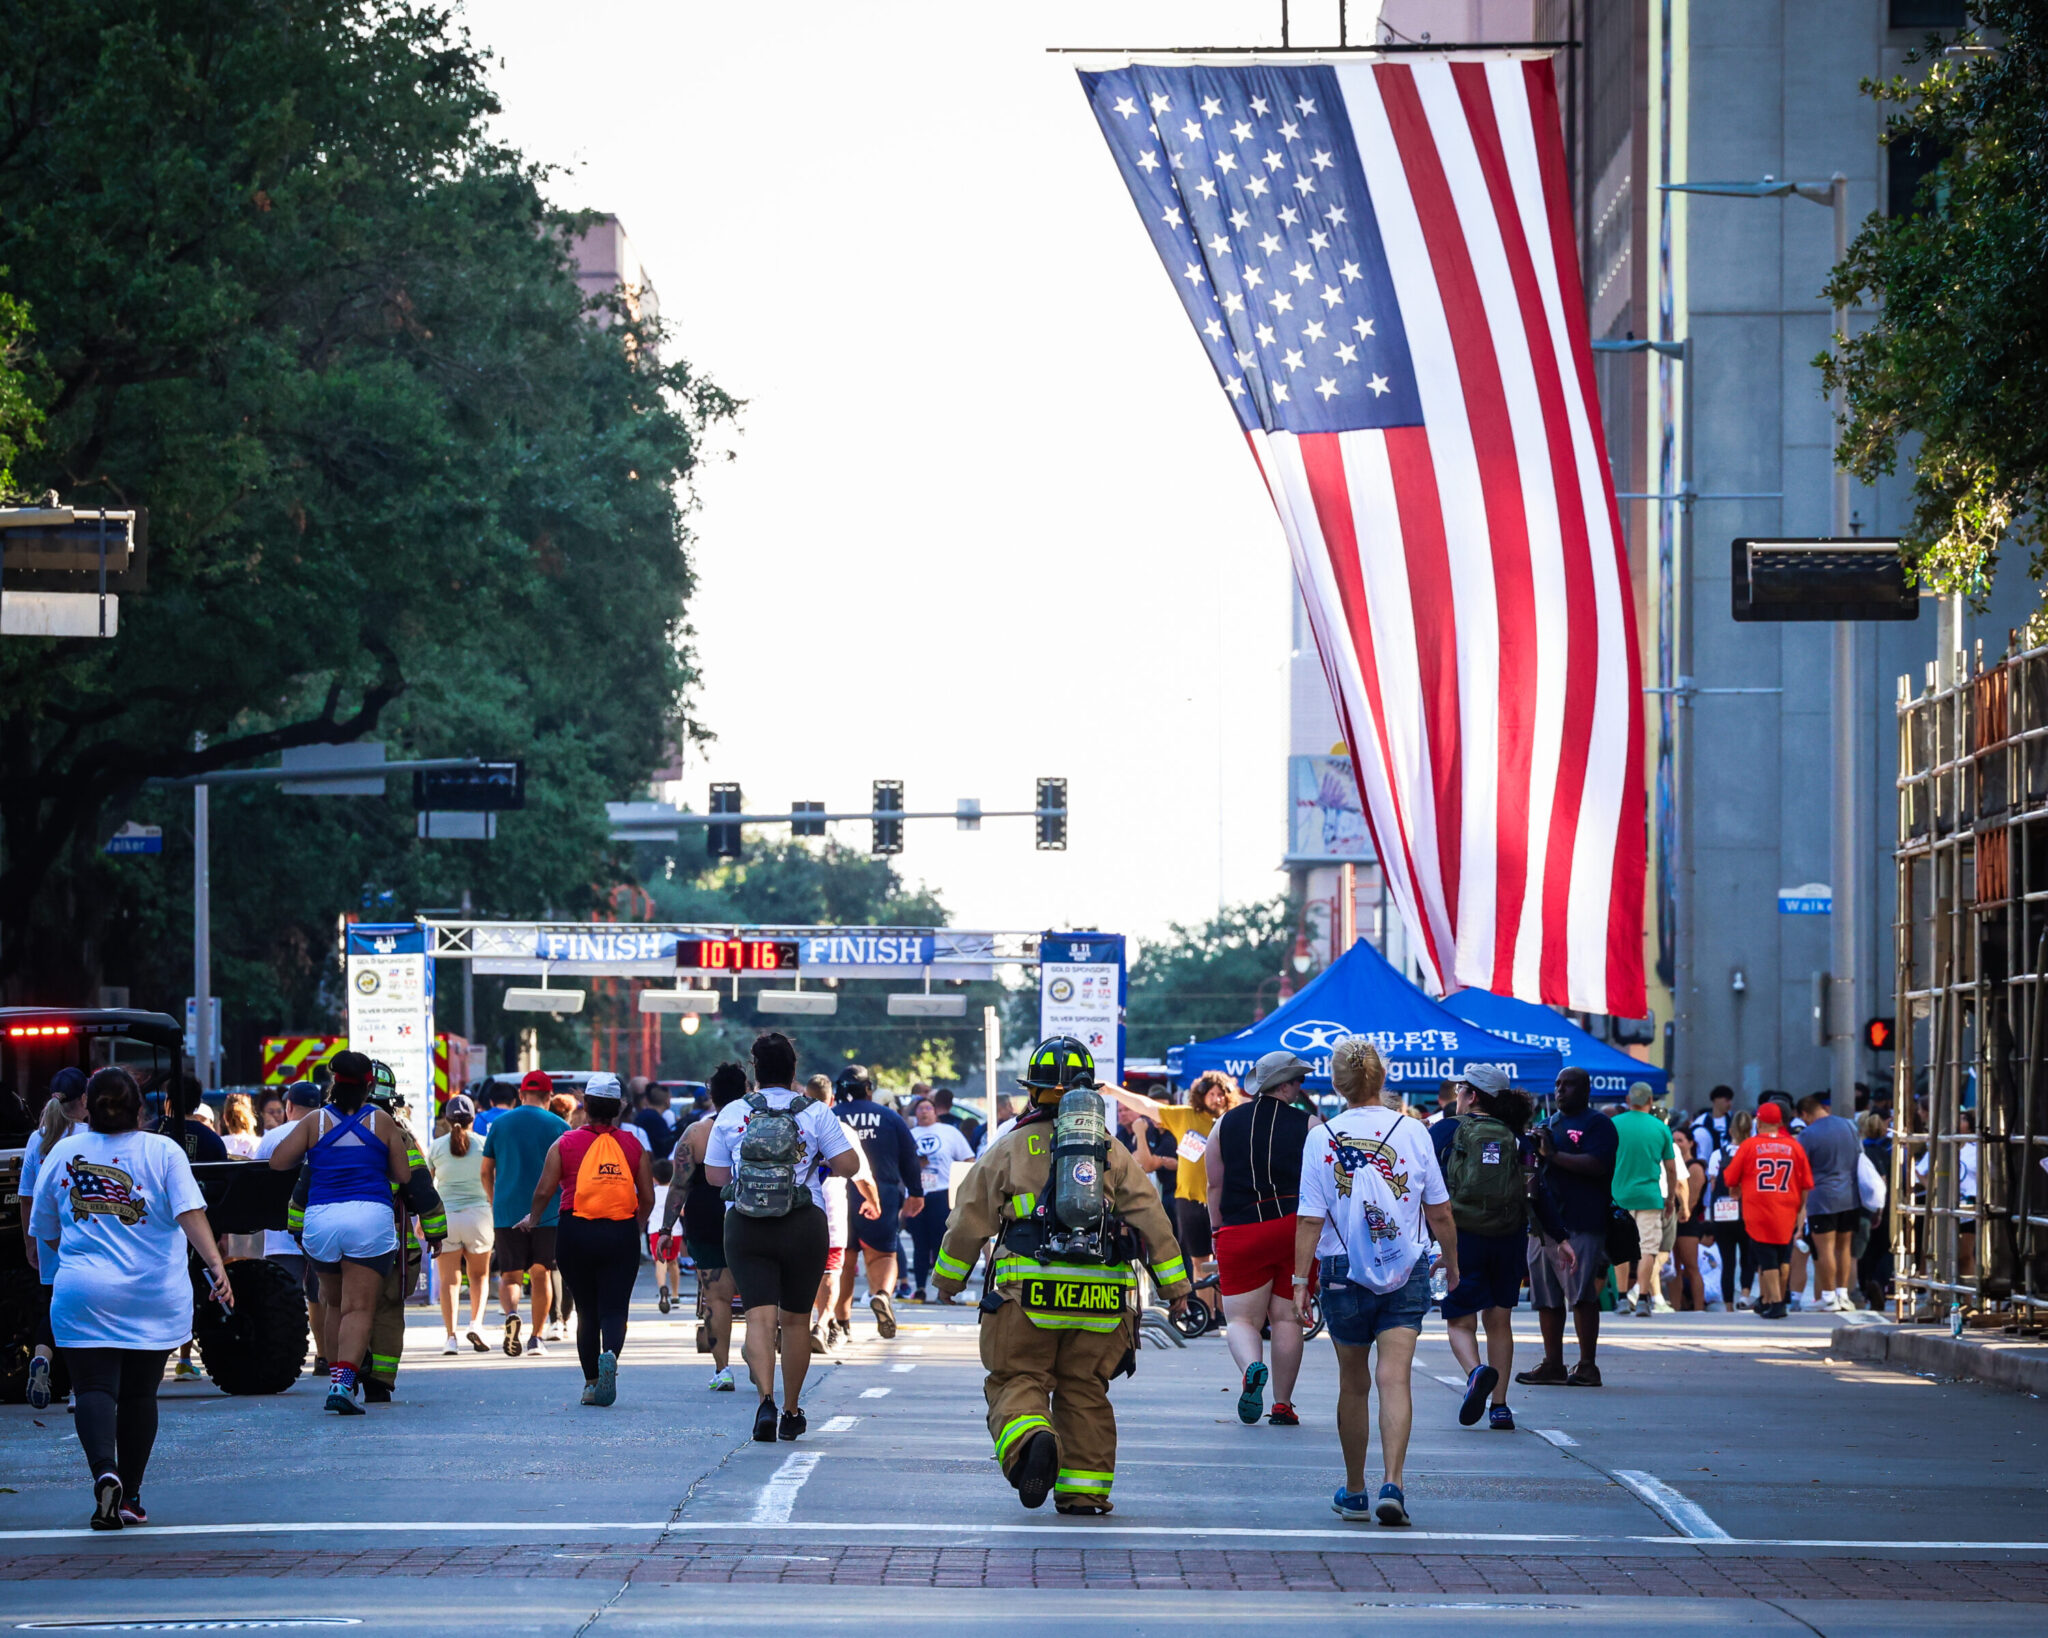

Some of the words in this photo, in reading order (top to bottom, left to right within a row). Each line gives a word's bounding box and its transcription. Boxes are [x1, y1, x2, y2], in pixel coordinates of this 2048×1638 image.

[1784, 900, 1832, 912] Walke
[546, 934, 662, 960] FINISH
[808, 937, 923, 964] FINISH
[1486, 1029, 1571, 1049] HLETE
[858, 1128, 877, 1140] EPT.
[1756, 1158, 1793, 1193] 27
[1030, 1281, 1047, 1306] G.
[1054, 1282, 1120, 1310] KEARNS
